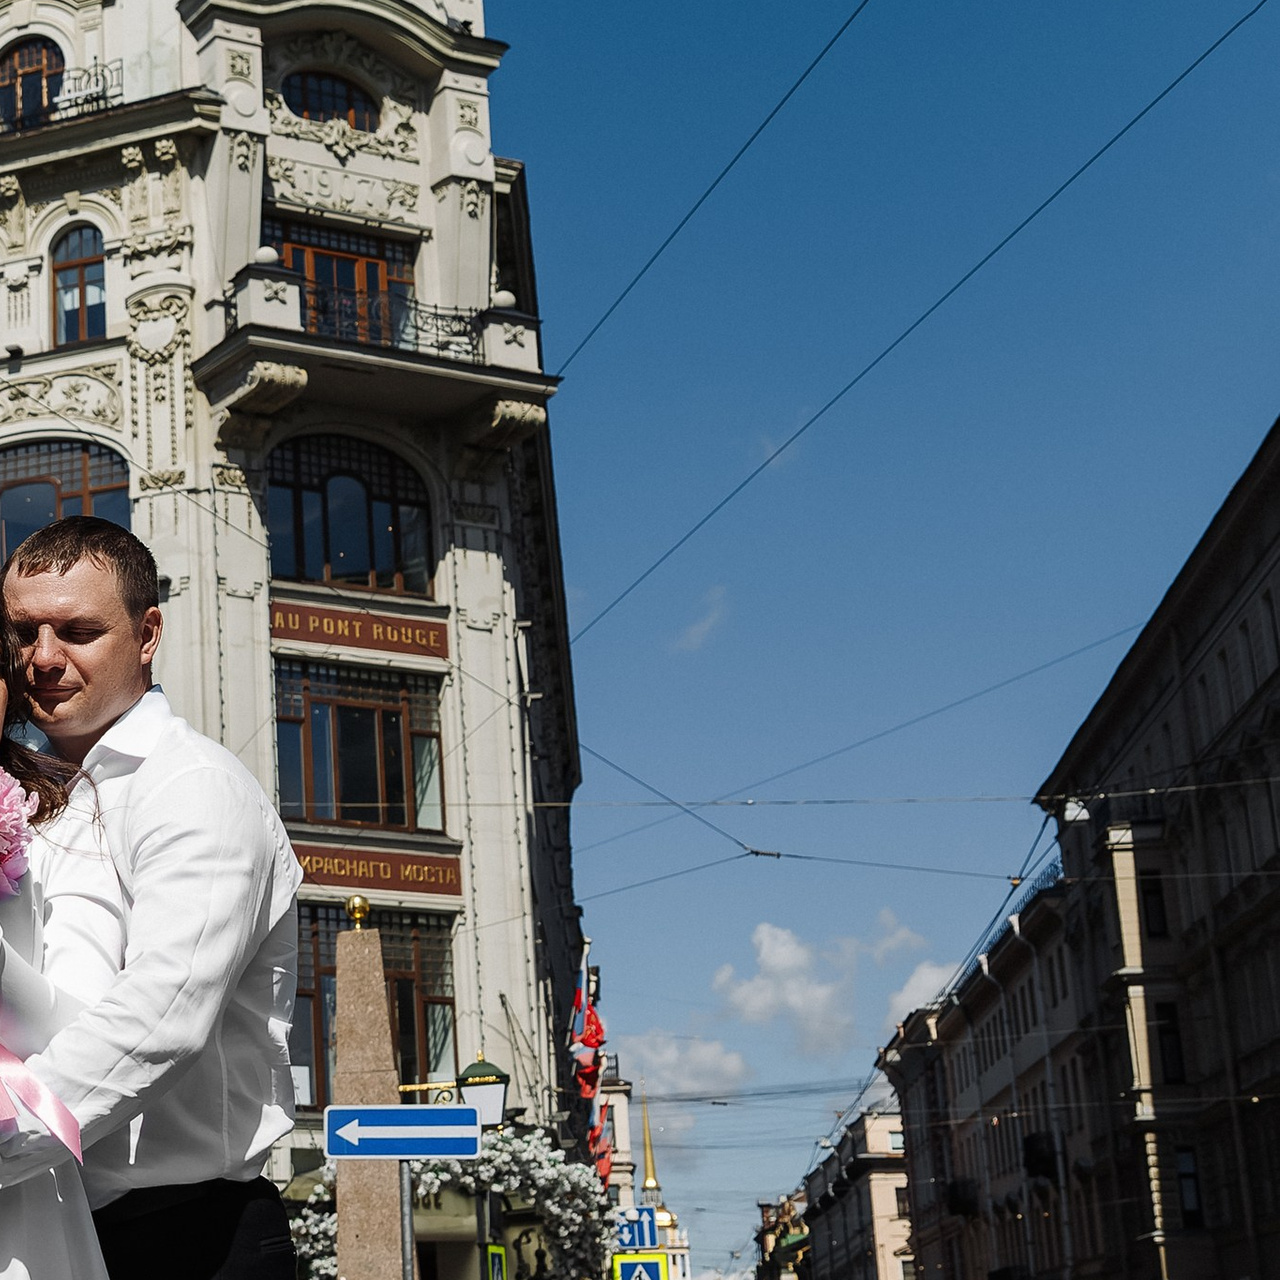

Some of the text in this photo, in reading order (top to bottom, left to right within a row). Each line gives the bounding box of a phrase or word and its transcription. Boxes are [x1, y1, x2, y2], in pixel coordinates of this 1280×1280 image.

[274, 611, 442, 647] AU PONT ROUGE
[299, 855, 458, 885] КРАСНАГО МОСТА
